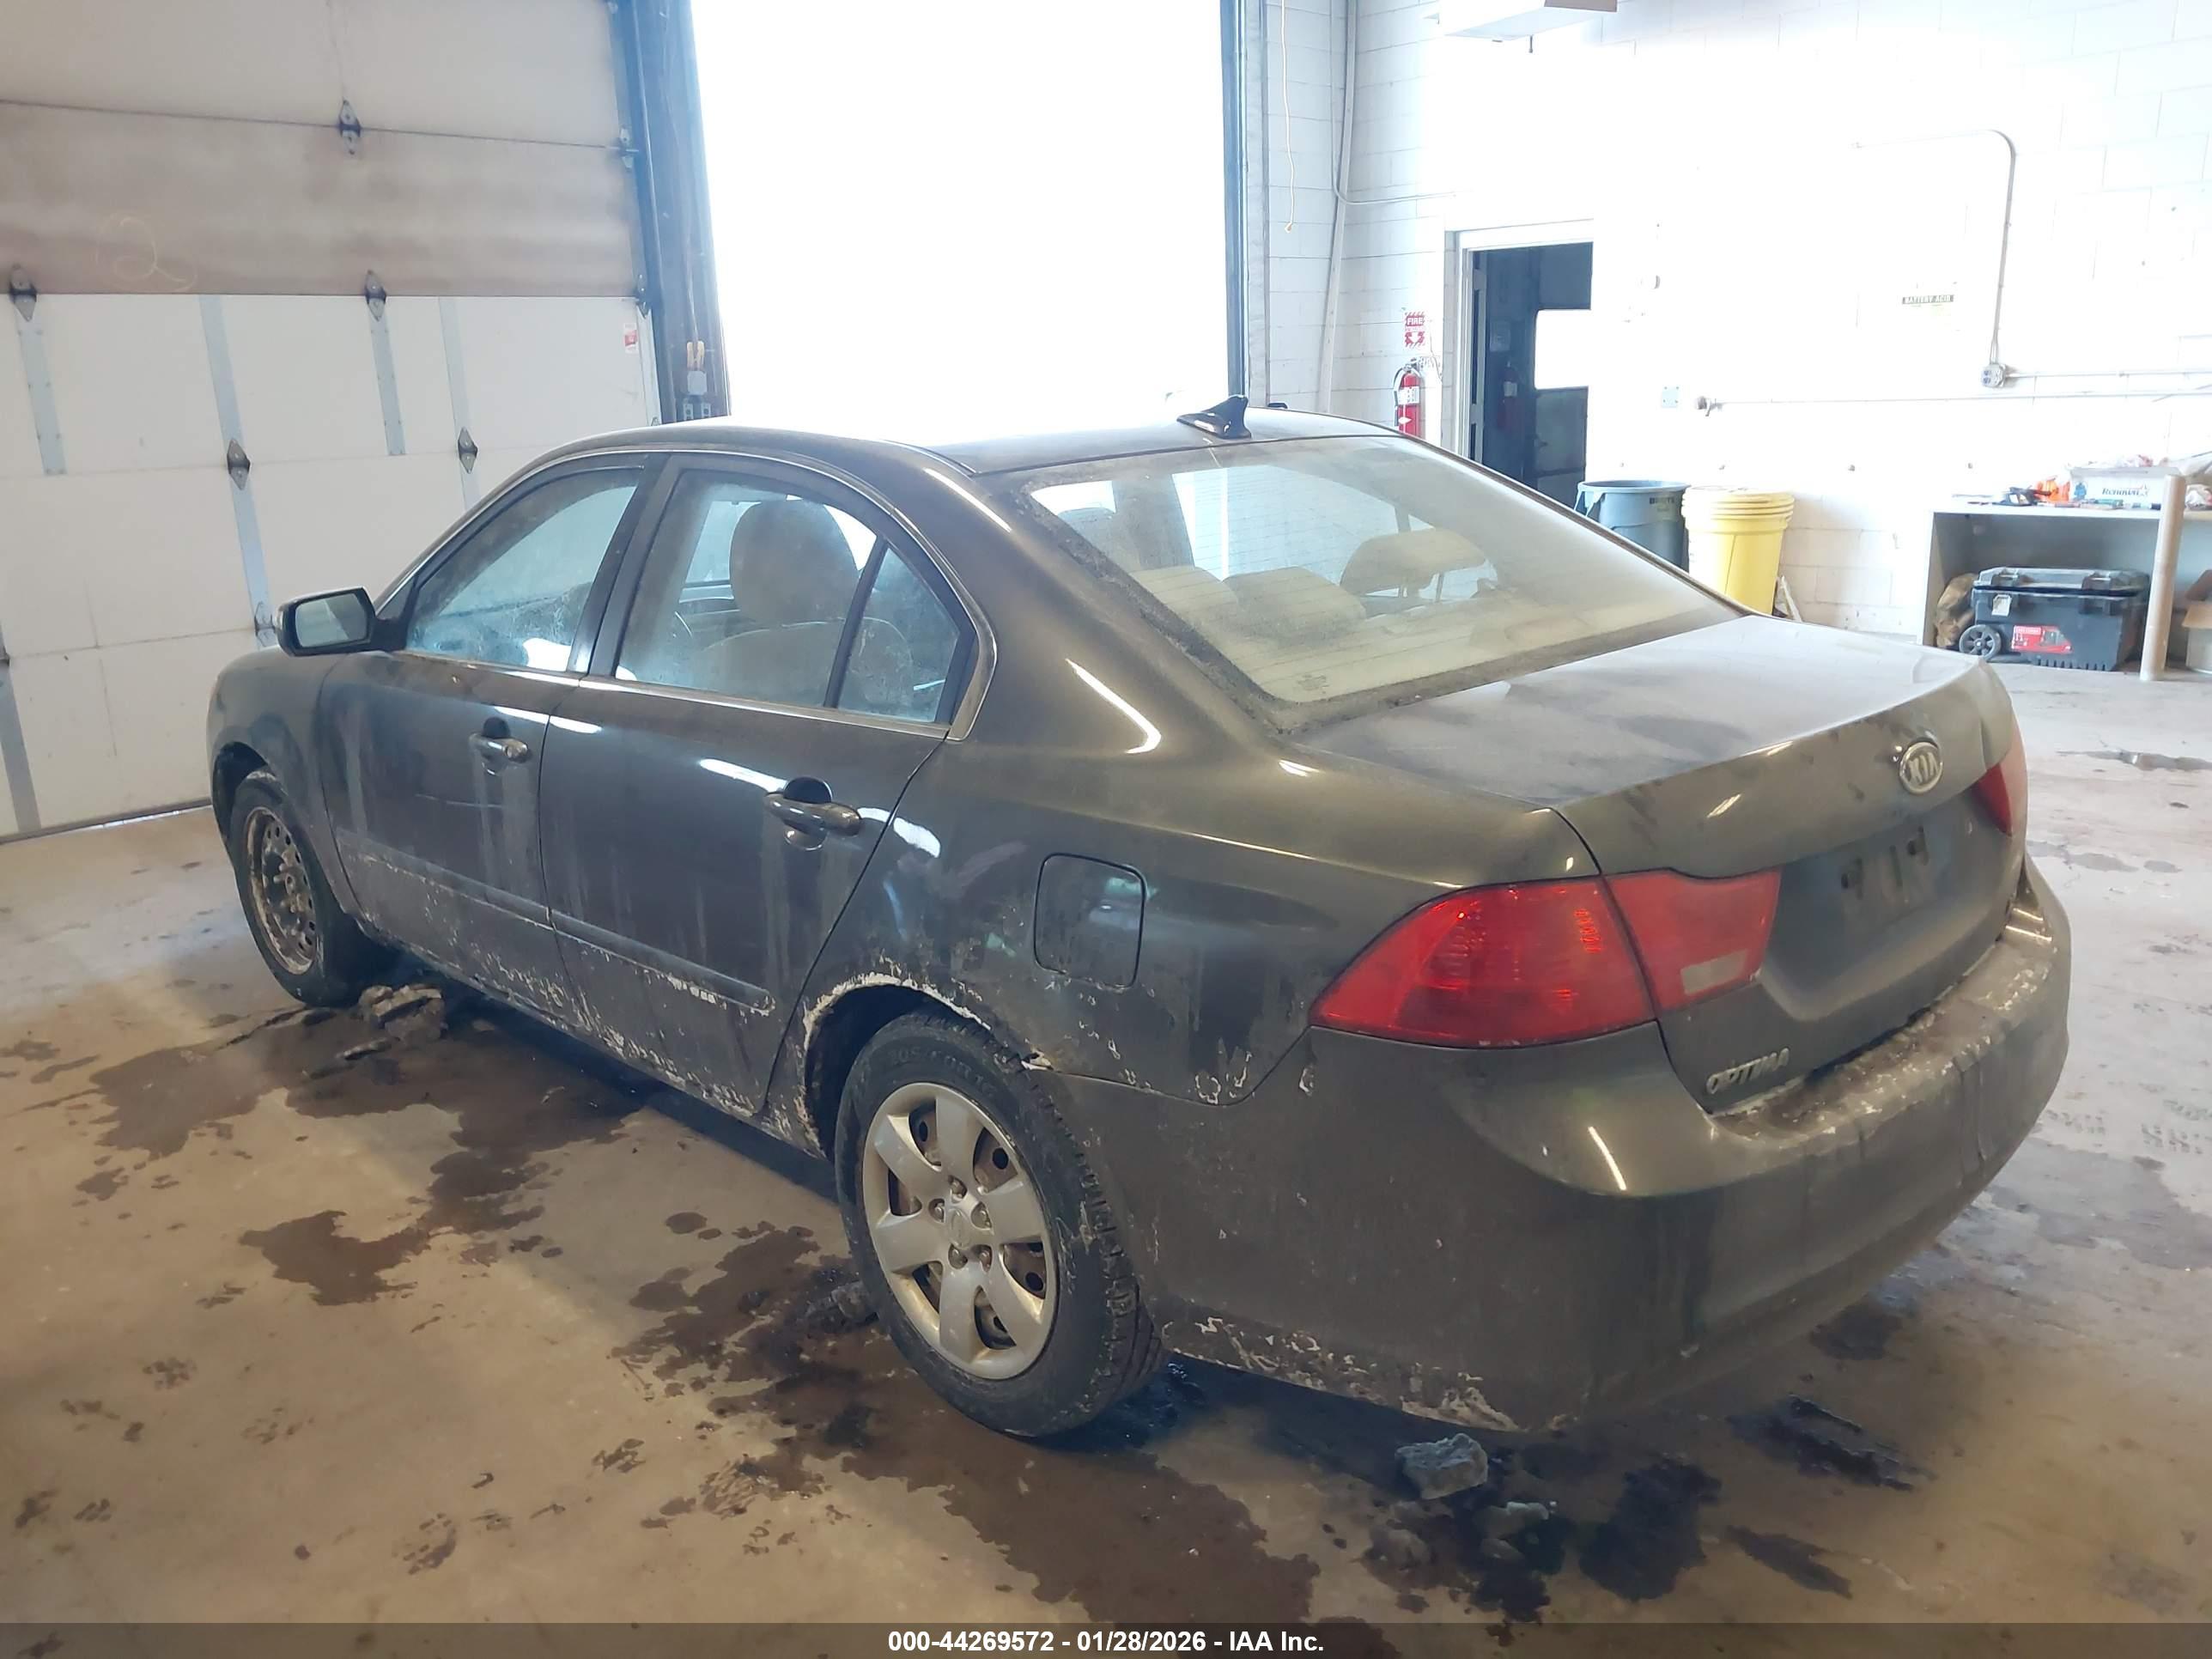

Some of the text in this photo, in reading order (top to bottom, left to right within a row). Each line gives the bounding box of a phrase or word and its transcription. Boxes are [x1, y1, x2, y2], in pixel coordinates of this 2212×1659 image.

[1407, 317, 1424, 325] FIRE
[1907, 751, 1939, 783] KIA
[1705, 1047, 1790, 1095] OPTIMA
